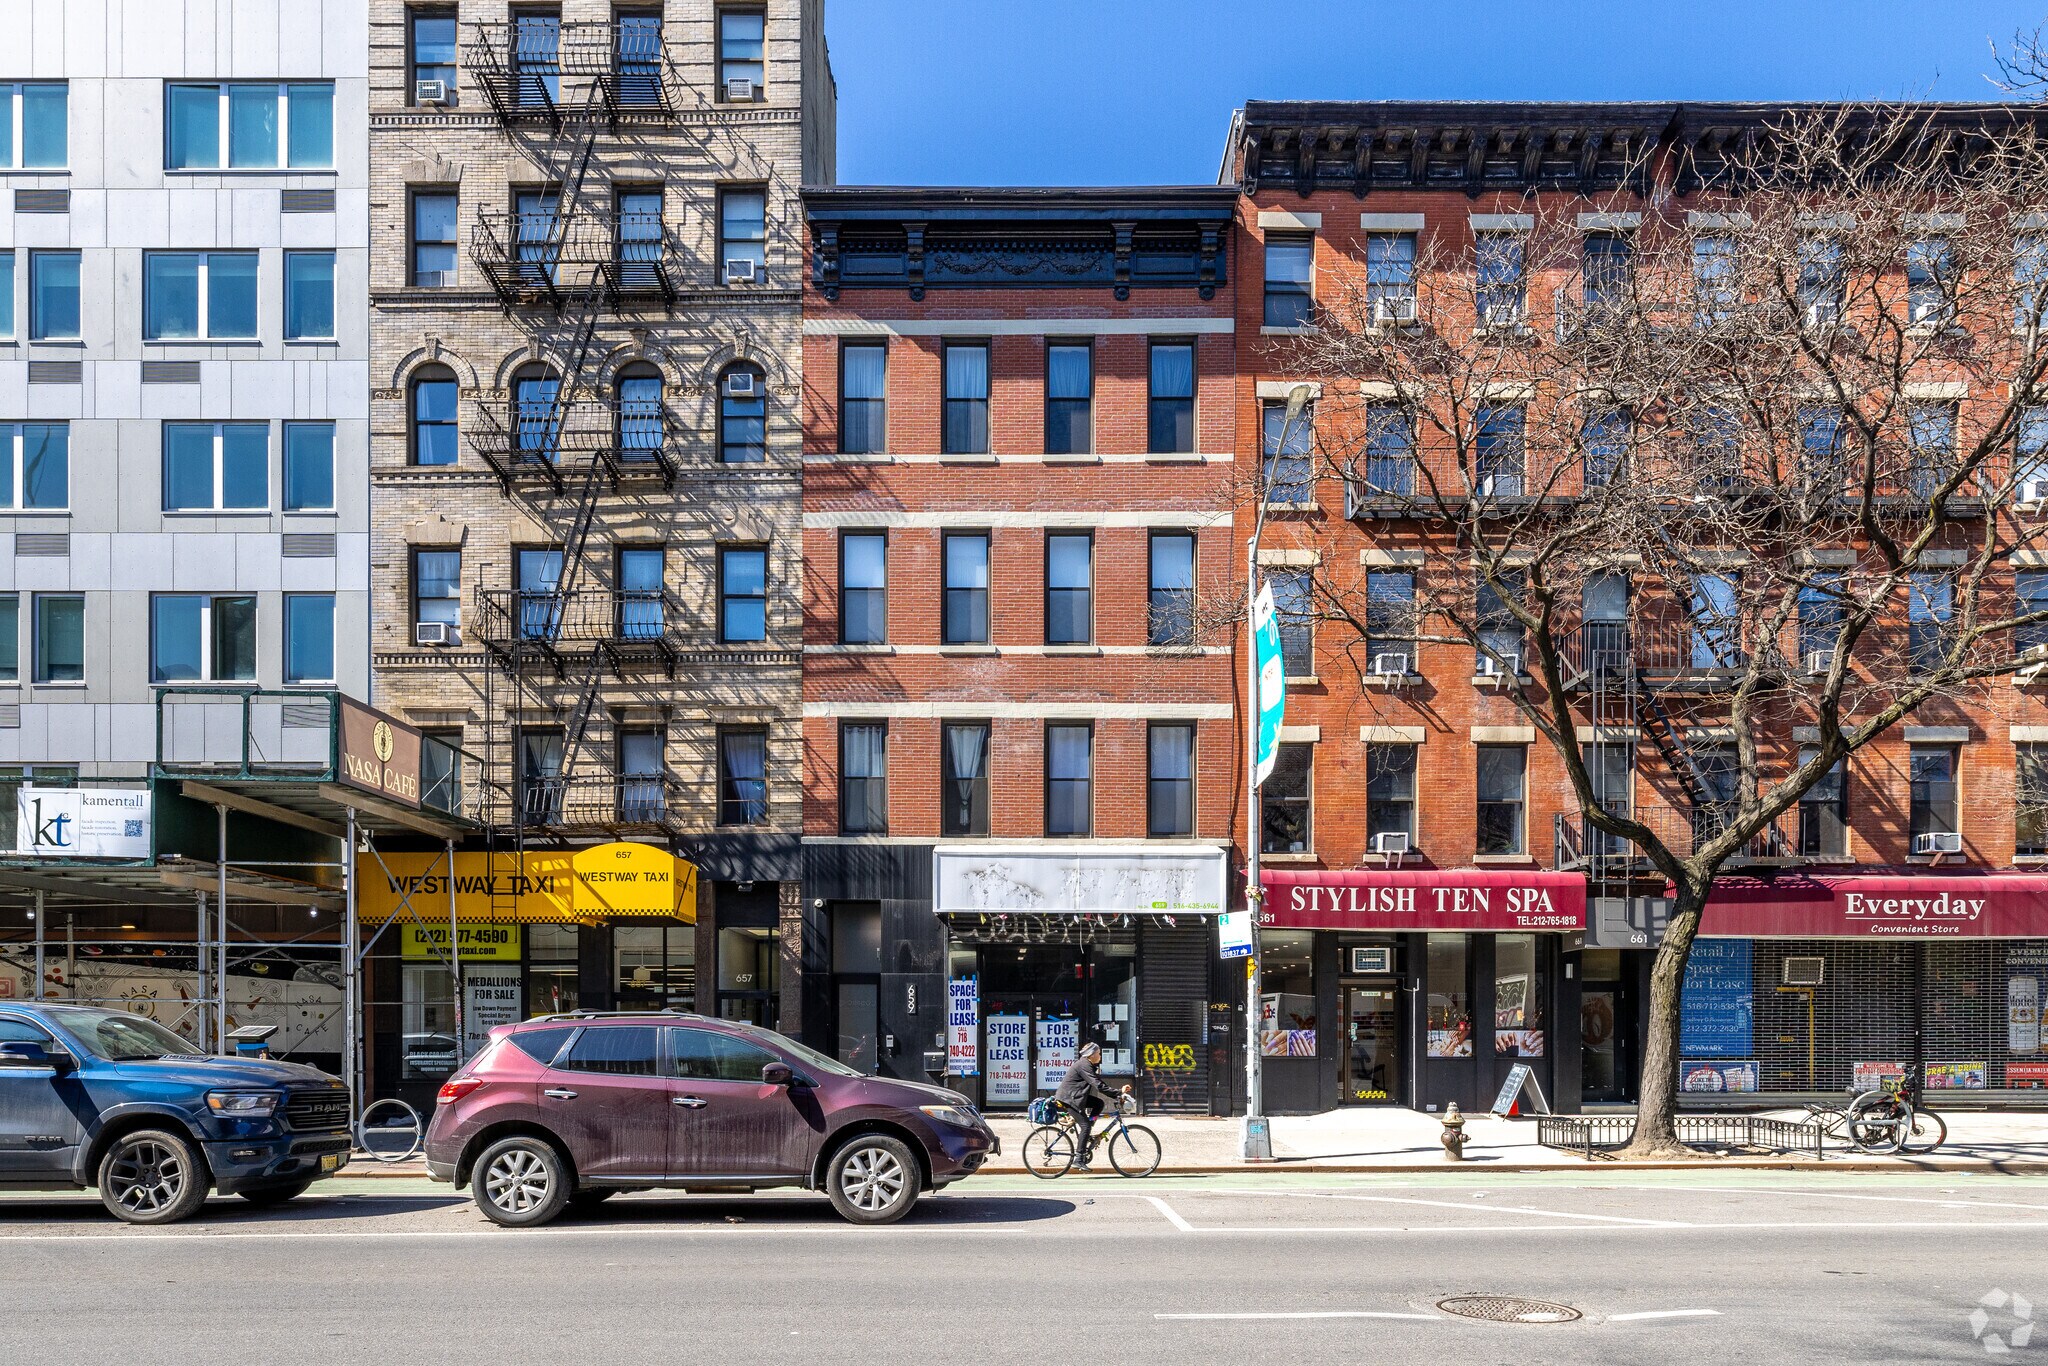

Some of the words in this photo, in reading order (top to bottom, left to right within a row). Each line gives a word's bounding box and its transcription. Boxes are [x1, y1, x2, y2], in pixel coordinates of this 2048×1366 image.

[344, 752, 382, 787] NASA
[383, 768, 417, 798] CAFÉ
[82, 793, 143, 807] kamentall
[615, 851, 632, 859] 657
[580, 872, 639, 882] WESTWAY
[644, 872, 669, 882] TAXI
[387, 876, 498, 894] WESTWAY
[507, 876, 555, 894] TAXI
[1291, 886, 1417, 912] STYLISH
[1432, 888, 1491, 912] TEN
[1506, 888, 1555, 912] SPA
[1845, 893, 1986, 920] Everyday
[1516, 915, 1577, 926] TEL:212-765-1818
[1871, 924, 1929, 934] Convenient
[1931, 924, 1960, 934] Store
[414, 929, 447, 943] (212)
[1631, 934, 1648, 944] 661
[426, 946, 497, 956] westwytaxi.com
[1685, 961, 1723, 977] Space
[467, 977, 522, 988] MEDALLIONS
[736, 974, 753, 983] 657
[1685, 978, 1706, 989] for
[1709, 978, 1745, 989] Lease
[120, 985, 158, 999] NASA
[474, 989, 492, 999] FOR
[494, 989, 515, 999] SALE
[950, 984, 976, 997] SPACE
[907, 984, 915, 1013] 659
[497, 1005, 517, 1013] Payment
[955, 999, 971, 1011] FOR
[950, 1012, 976, 1026] LEASE
[989, 1023, 1026, 1035] STORE
[1047, 1024, 1070, 1035] FOR
[468, 1032, 481, 1040] The
[957, 1032, 968, 1043] 718
[997, 1036, 1019, 1047] FOR
[1040, 1037, 1075, 1048] LEASE
[949, 1045, 976, 1057] 740-4222
[989, 1049, 1025, 1061] LEASE
[989, 1071, 1027, 1079] 718-740-4222
[313, 1104, 341, 1113] RAM
